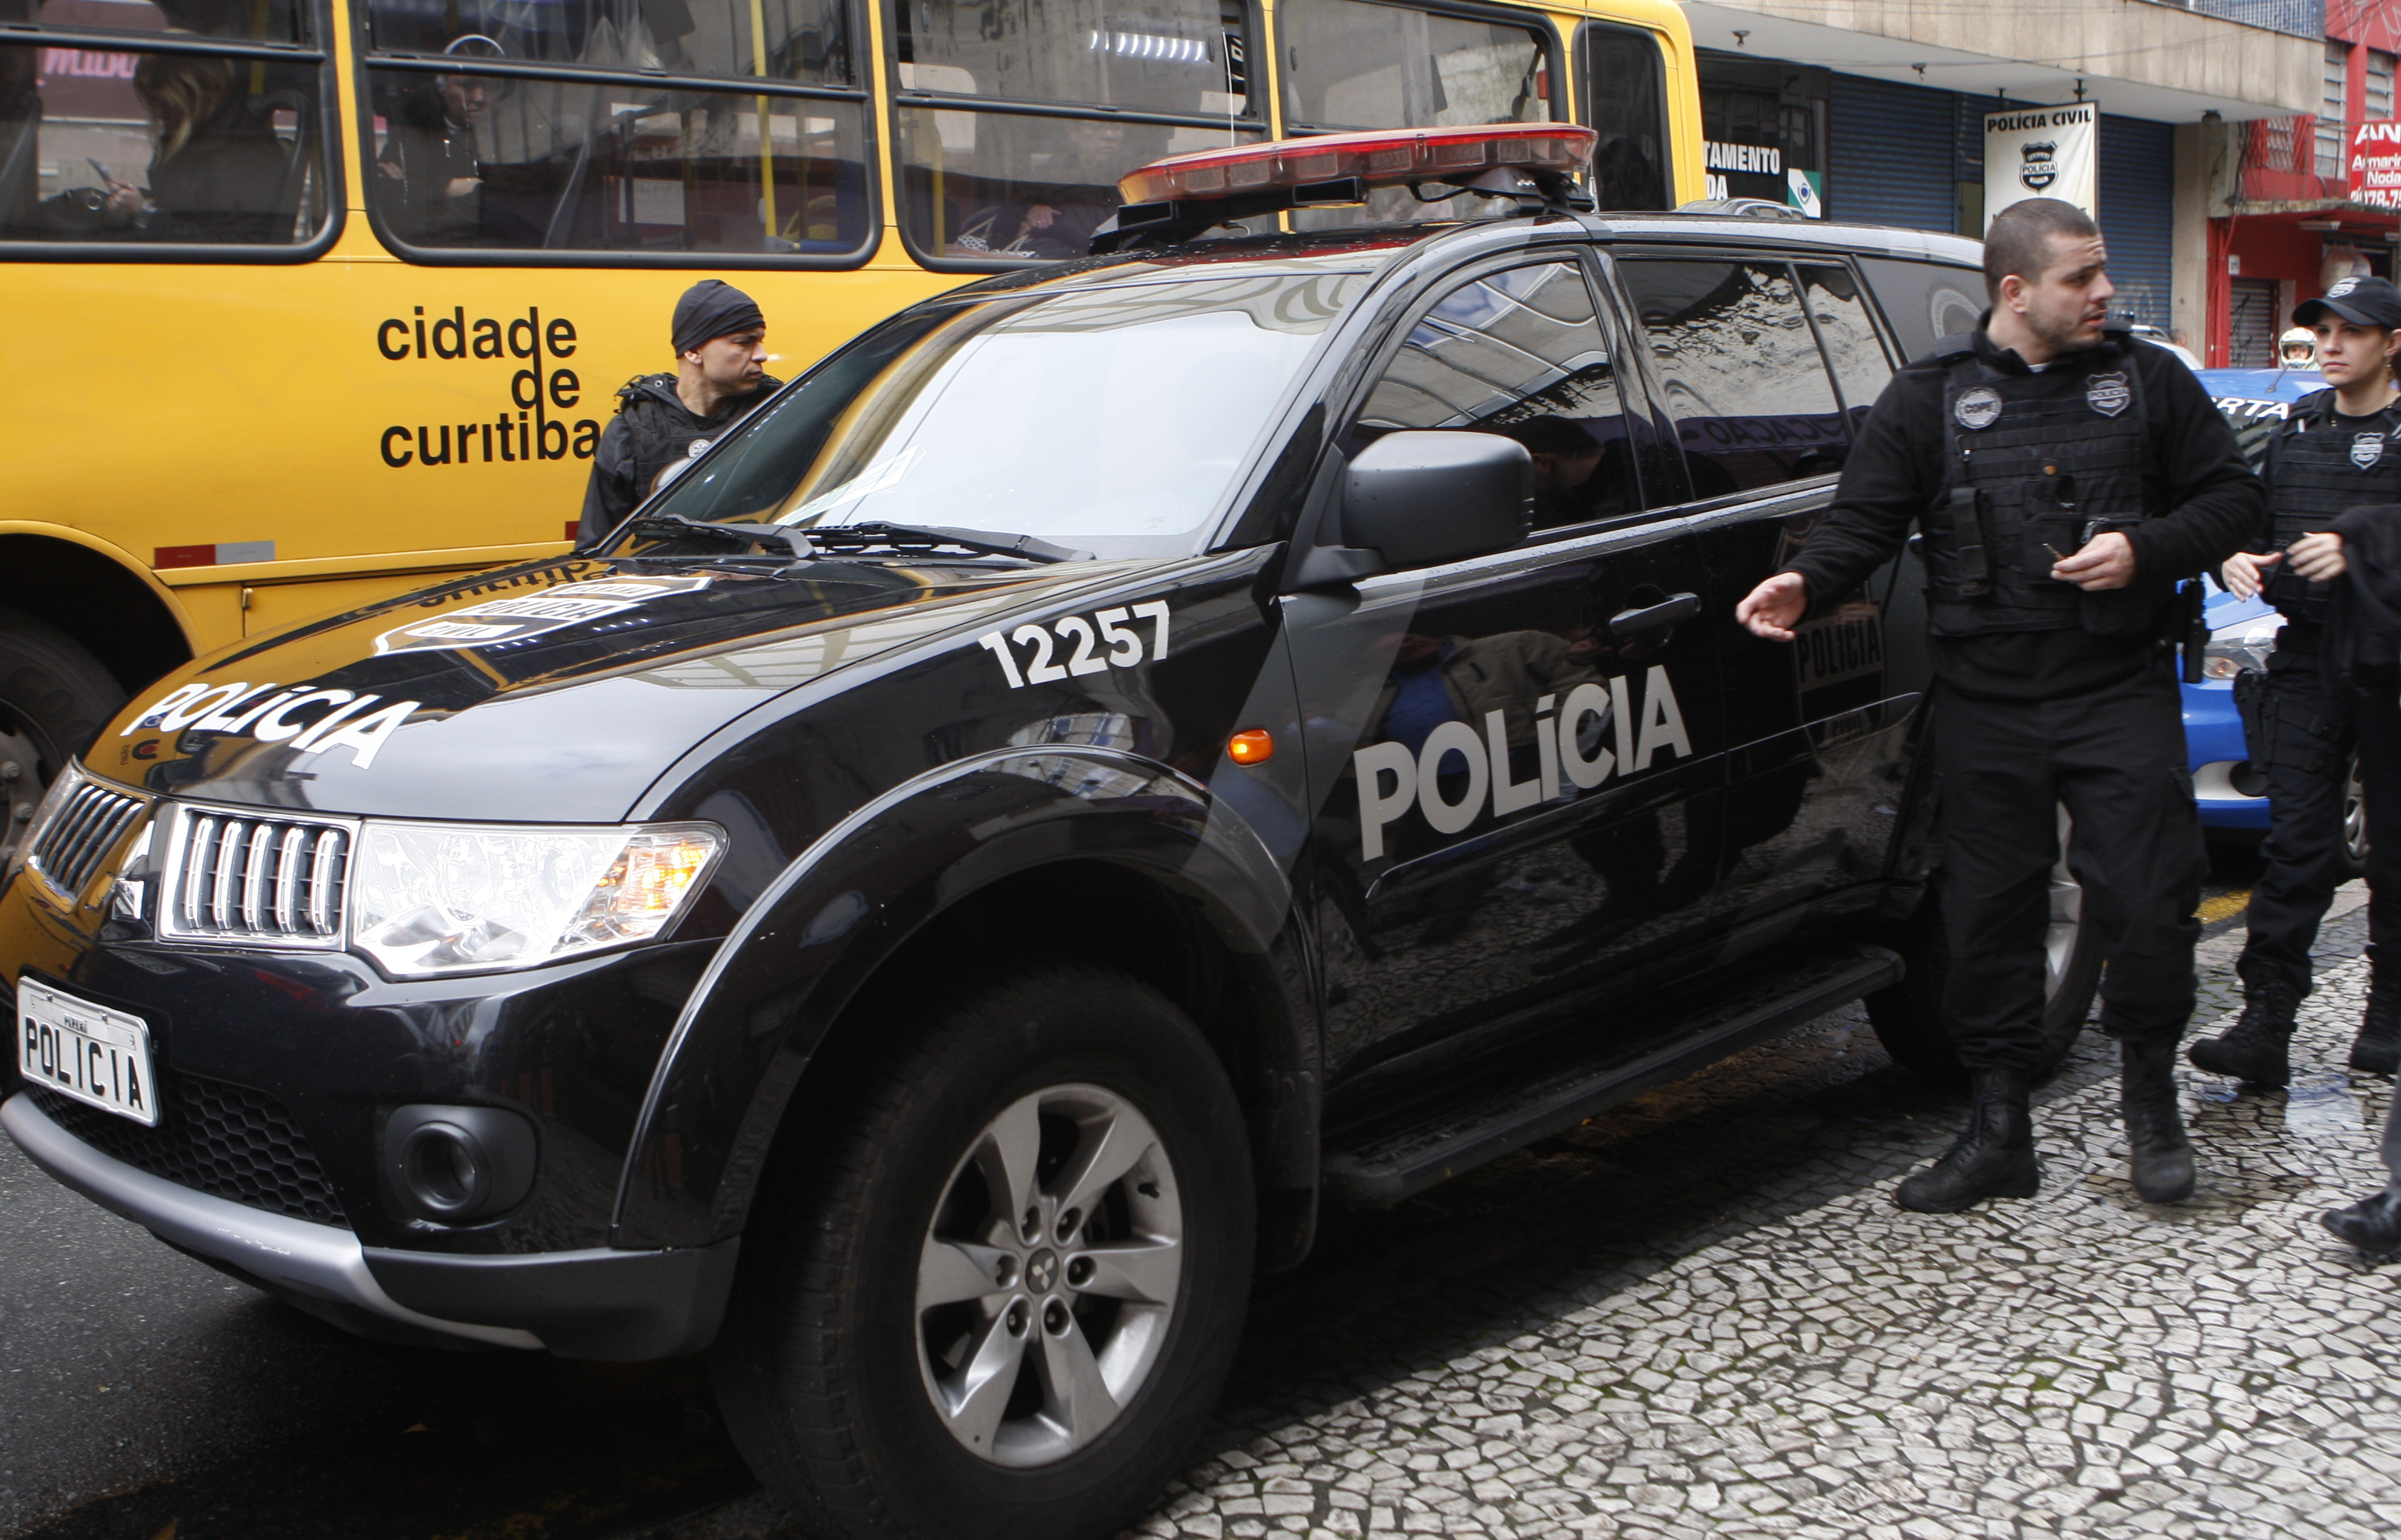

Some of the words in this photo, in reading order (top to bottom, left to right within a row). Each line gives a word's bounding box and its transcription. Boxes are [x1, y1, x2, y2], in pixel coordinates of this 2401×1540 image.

[1988, 112, 2047, 132] POLÍCIA
[2052, 109, 2091, 126] CIVIL
[378, 306, 576, 361] cidade
[511, 368, 581, 410] de
[2211, 396, 2290, 421] RTA
[381, 411, 601, 468] curitiba
[978, 600, 1171, 689] 12257
[26, 1016, 145, 1112] POLICIA
